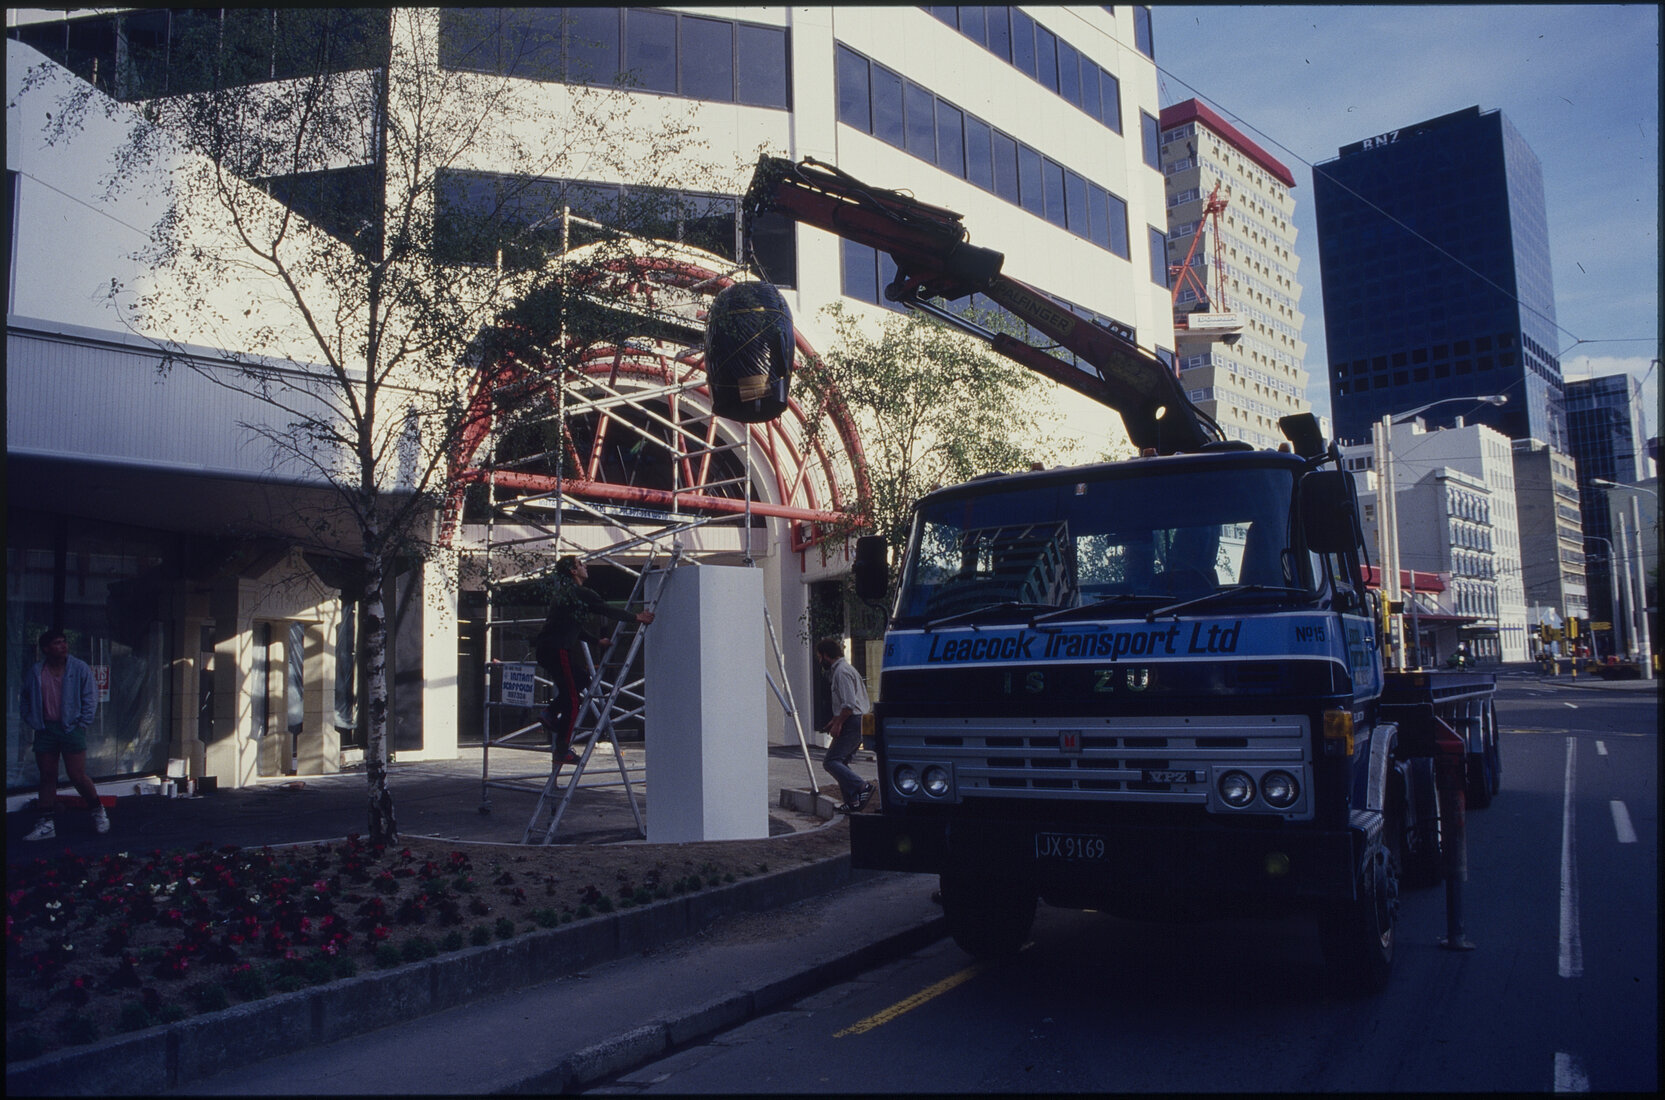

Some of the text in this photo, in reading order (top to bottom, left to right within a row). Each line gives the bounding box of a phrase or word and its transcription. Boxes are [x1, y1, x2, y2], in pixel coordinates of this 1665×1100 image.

[996, 282, 1071, 332] PALFINGER
[927, 621, 1241, 663] Leacock Transport Ltd
[510, 671, 533, 682] INSTANT
